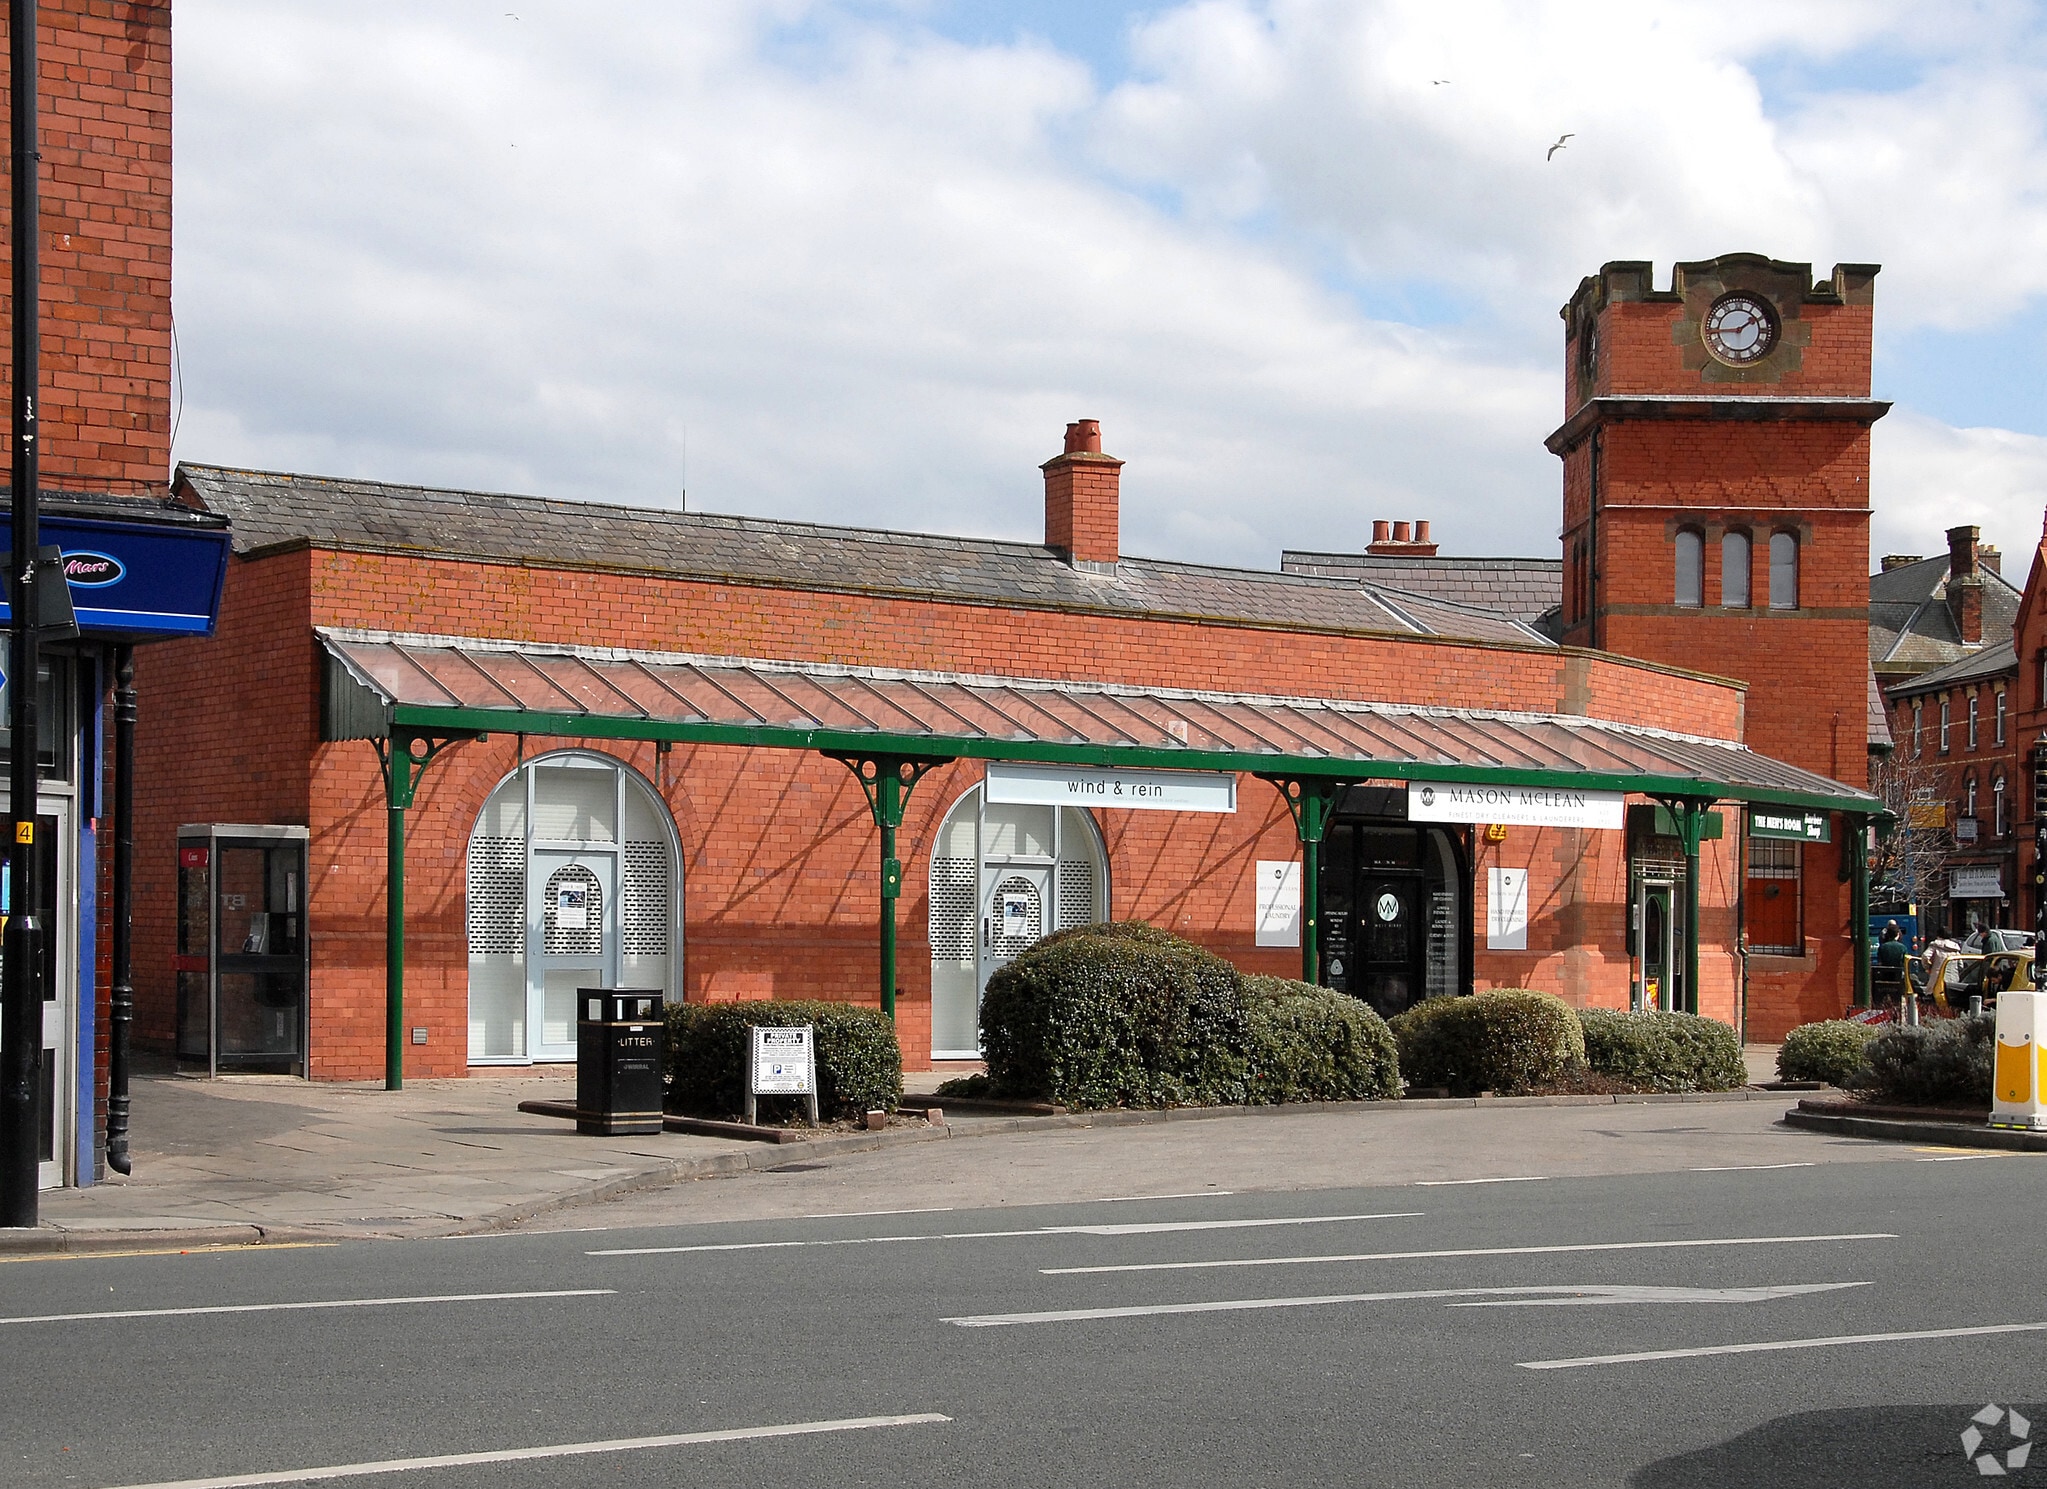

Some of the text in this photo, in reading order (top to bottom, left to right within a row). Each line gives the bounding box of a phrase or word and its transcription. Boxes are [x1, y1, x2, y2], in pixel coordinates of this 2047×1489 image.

[64, 560, 109, 574] Mars
[1067, 779, 1162, 797] wind & rein
[1450, 787, 1511, 804] MASON
[1475, 812, 1490, 820] DRY
[1492, 813, 1529, 822] CLEANERS
[1755, 815, 1766, 827] THE
[1784, 818, 1801, 831] ROOM
[19, 825, 31, 840] 4
[620, 1037, 653, 1047] LITTER
